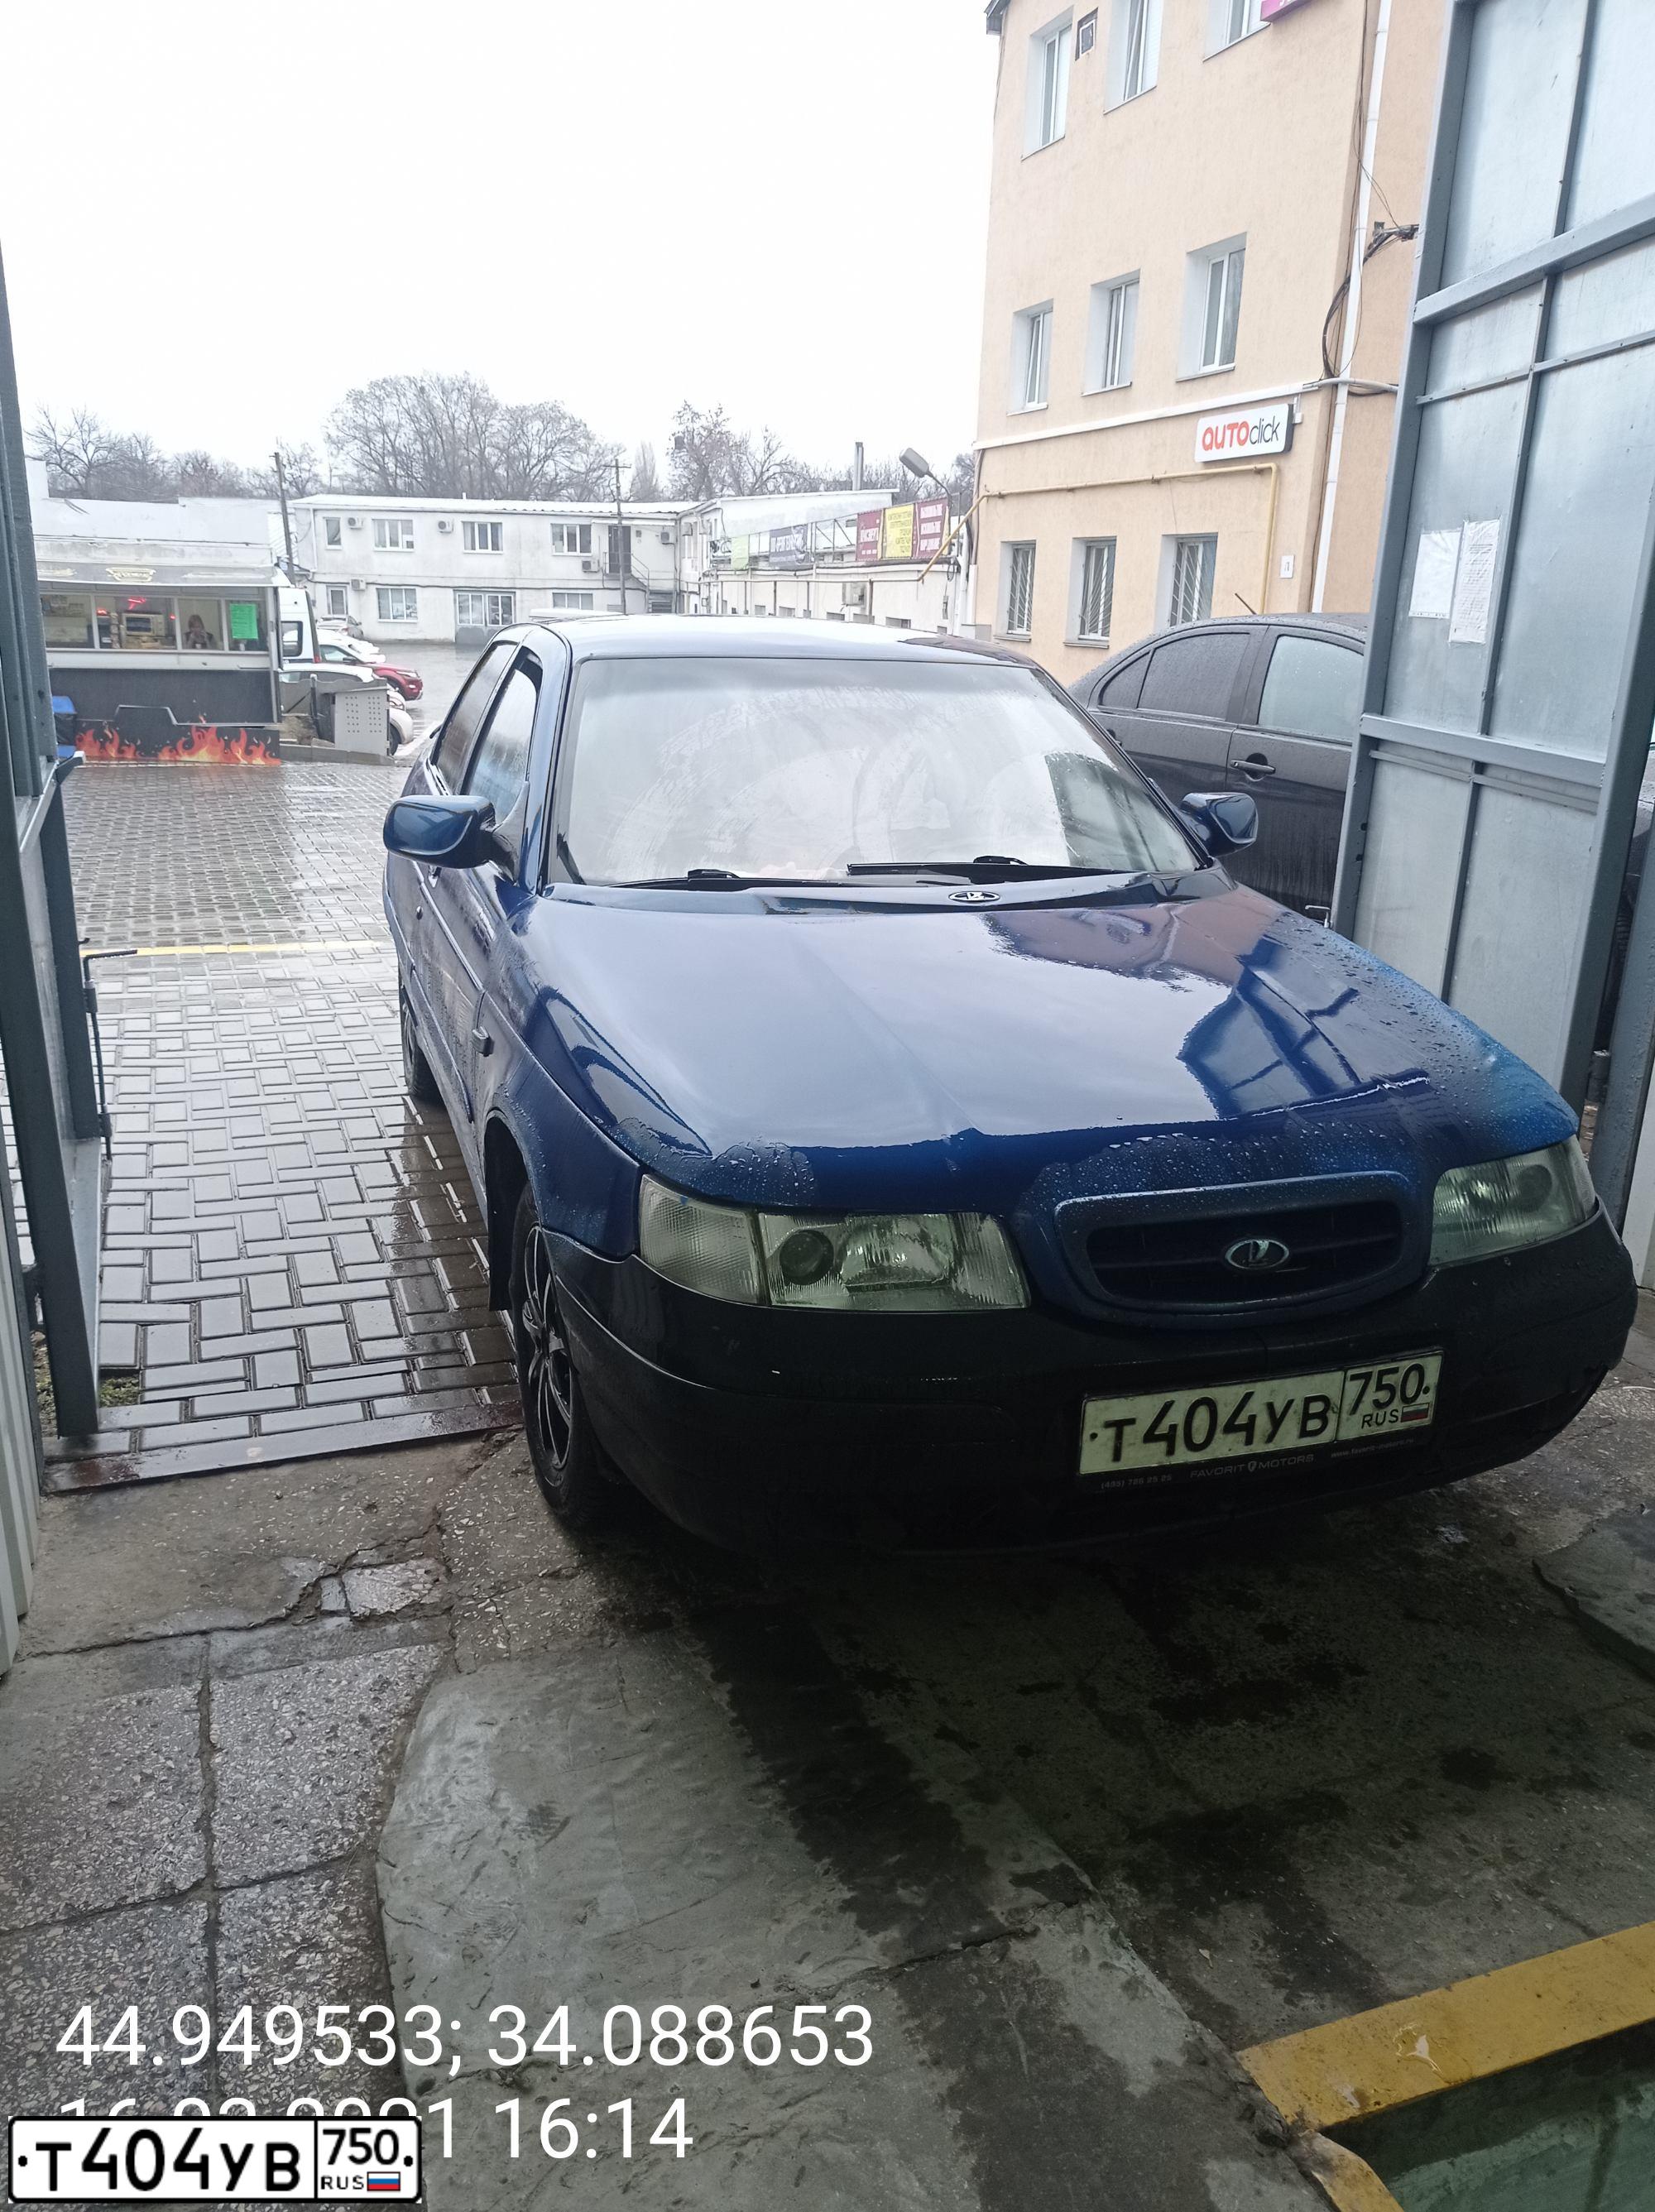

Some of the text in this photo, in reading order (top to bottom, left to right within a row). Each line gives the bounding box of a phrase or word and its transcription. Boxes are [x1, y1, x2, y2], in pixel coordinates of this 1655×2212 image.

[1104, 1363, 1426, 1462] Т404УВ 750
[1361, 1408, 1398, 1429] RUS
[1190, 1454, 1314, 1479] FAVORIT MOTORS
